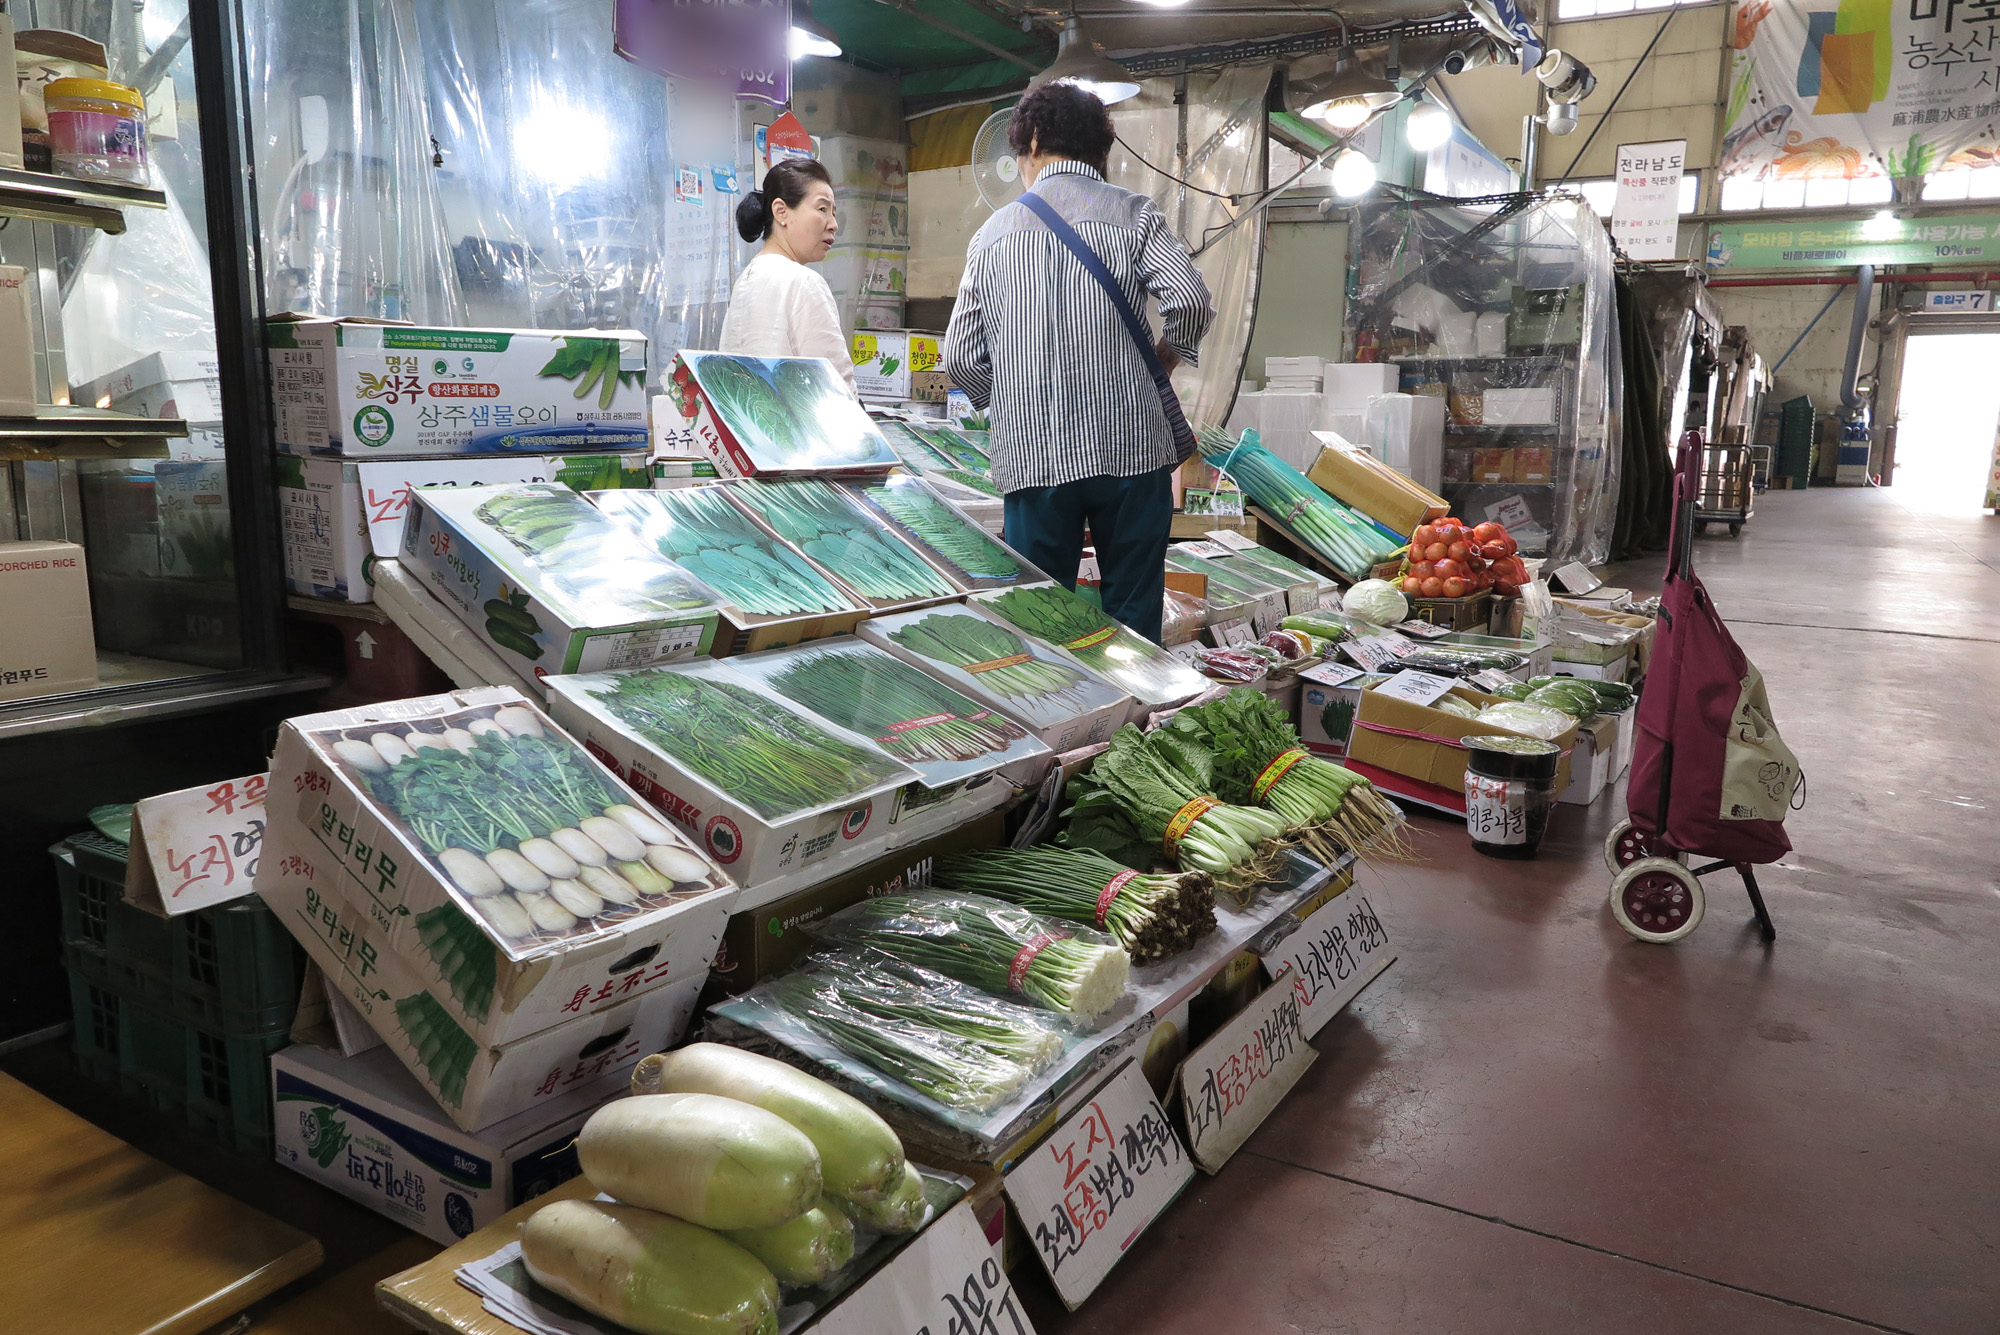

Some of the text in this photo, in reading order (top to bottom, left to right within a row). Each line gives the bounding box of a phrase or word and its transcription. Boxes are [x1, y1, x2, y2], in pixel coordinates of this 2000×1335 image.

[1620, 155, 1681, 172] 전라남도
[1651, 175, 1677, 186] 직판장
[1935, 244, 1963, 257] 10%
[1933, 293, 1985, 308] 출입구 7
[911, 351, 943, 366] 청양고추
[416, 404, 558, 429] 상주샘물오이
[52, 558, 77, 569] RICE
[294, 771, 331, 796] 고랭지
[1467, 803, 1525, 839] 리콩나물
[320, 802, 398, 893] 알타리무
[280, 856, 316, 880] 고랭지
[305, 886, 378, 977] 알타리무
[370, 903, 392, 933] 5kg
[353, 986, 373, 1015] 5kg
[560, 960, 670, 1014] 身土不二
[533, 1040, 640, 1097] 身土不二
[1050, 1101, 1116, 1190] 노지
[345, 1143, 405, 1199] 애호박
